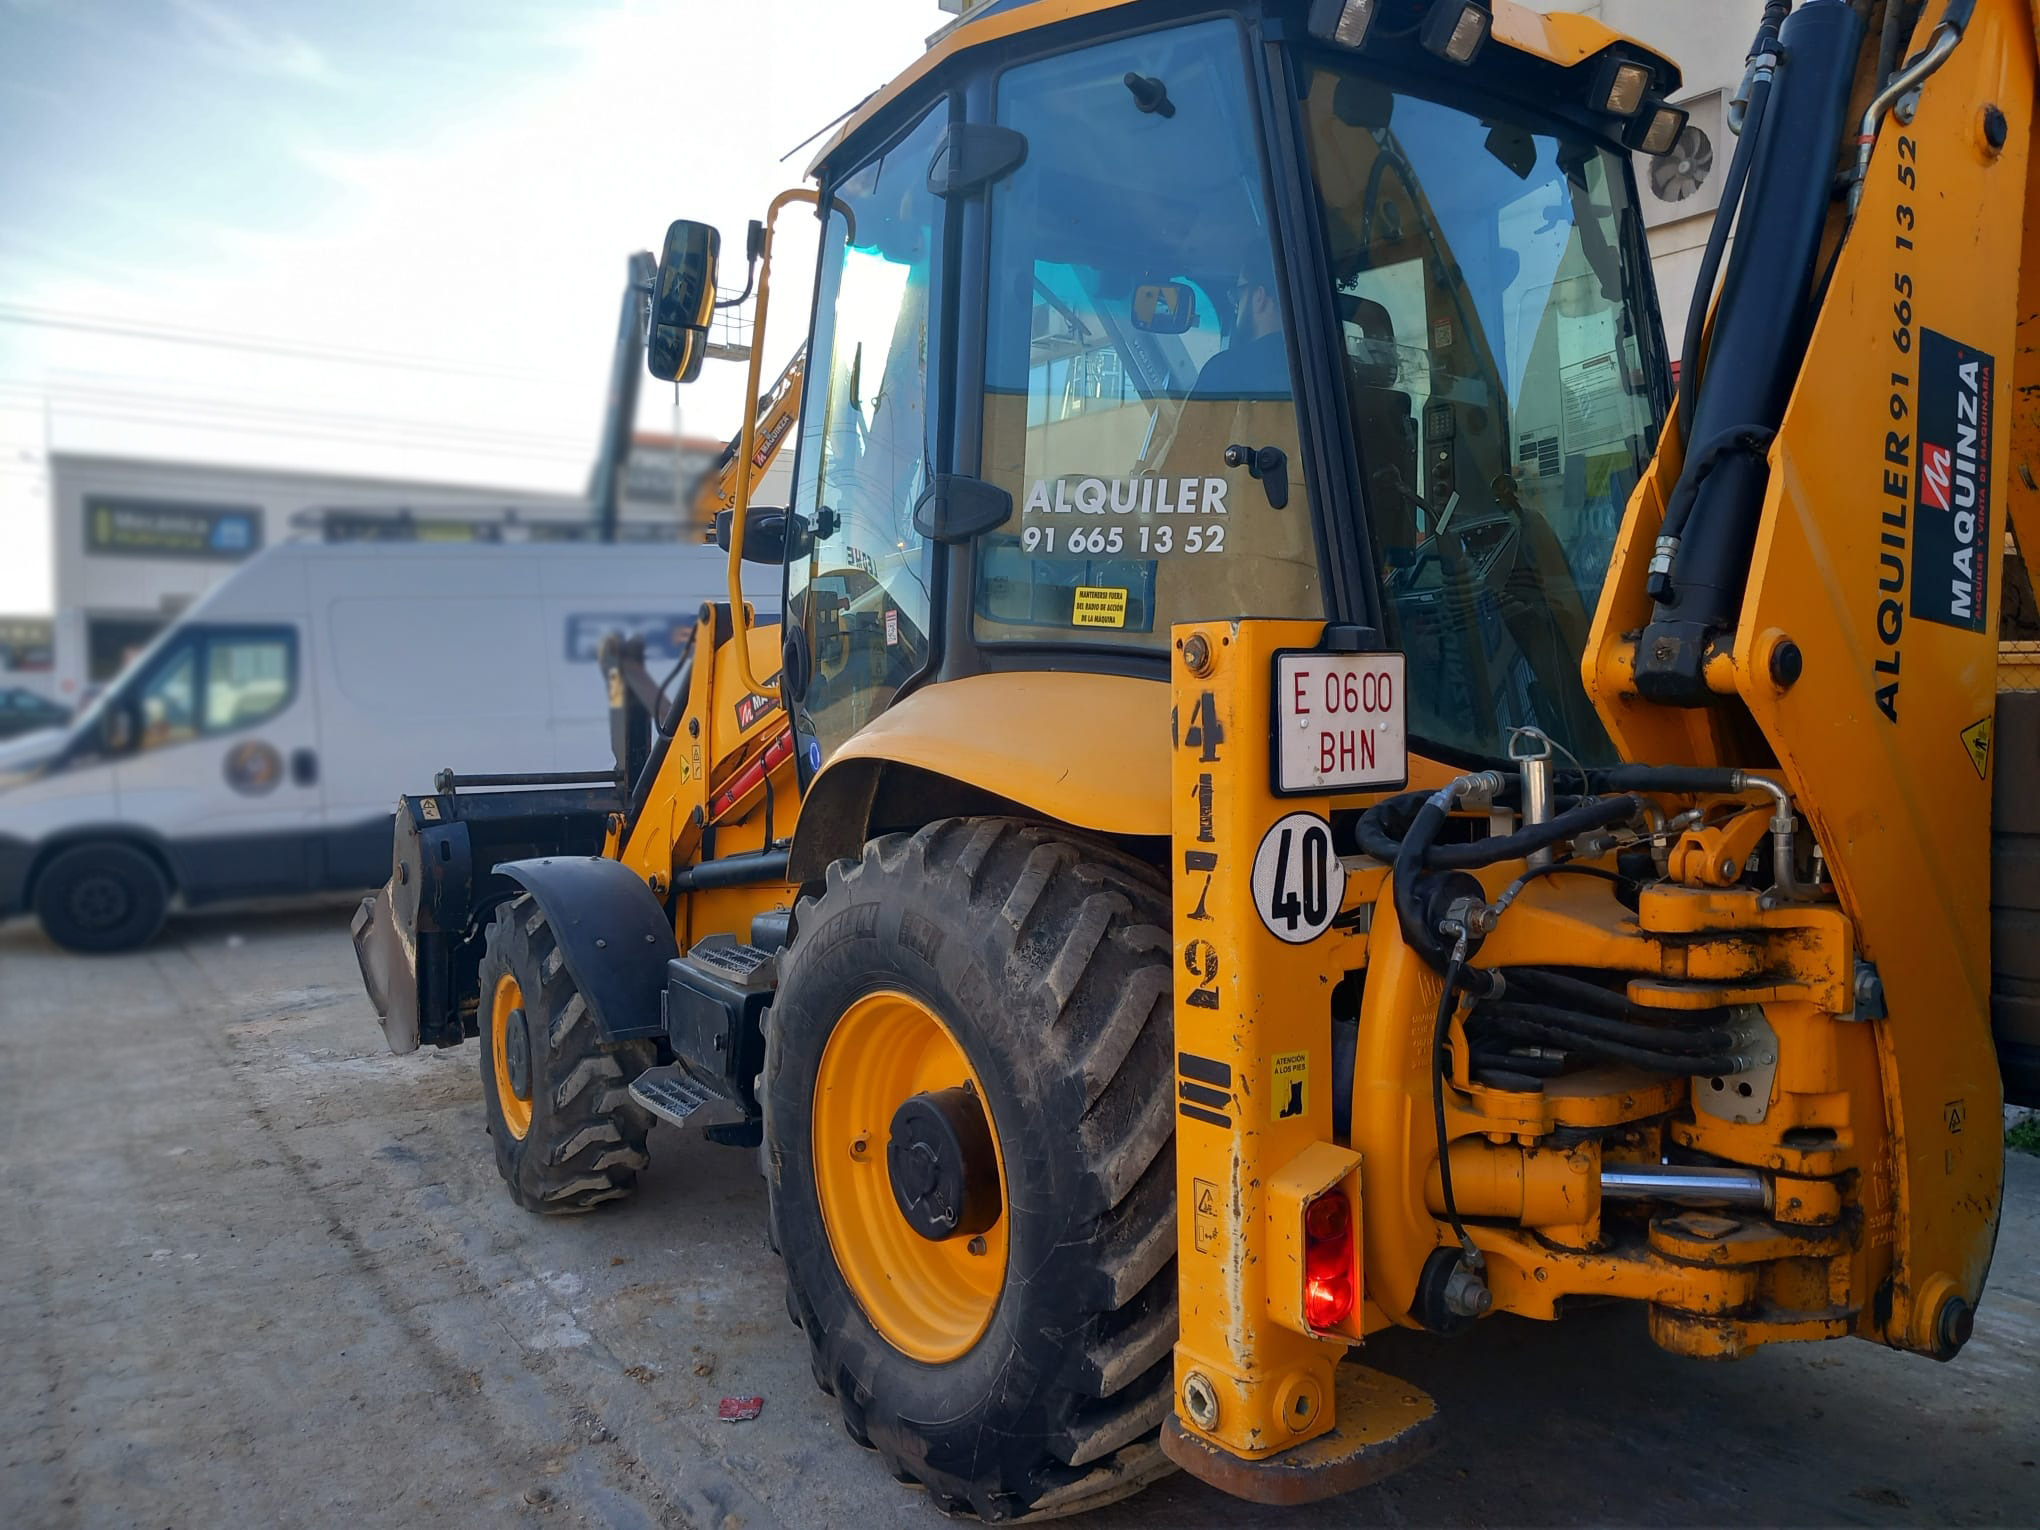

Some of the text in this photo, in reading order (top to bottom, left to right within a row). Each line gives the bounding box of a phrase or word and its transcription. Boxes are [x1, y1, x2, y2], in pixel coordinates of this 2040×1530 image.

[1874, 135, 1916, 725] ALQUILER 91 665 13 52
[1980, 367, 1991, 461] MAQUINARIA
[1951, 361, 1979, 619] MAQUINZA
[1979, 464, 1987, 482] DE
[1023, 478, 1229, 515] ALQUILER
[1977, 489, 1986, 533] VENTA
[1023, 524, 1226, 554] 91 665 13 52
[1080, 591, 1122, 600] MANTENERSE FUERA
[1085, 602, 1100, 611] RADIO
[1100, 603, 1106, 611] DE
[1974, 552, 1985, 620] ALQUILER
[1293, 671, 1393, 715] E 0600
[1320, 729, 1376, 774] BHN
[1271, 826, 1328, 931] 40
[1274, 1066, 1279, 1075] A
[1279, 1065, 1292, 1074] LOS
[1276, 1054, 1305, 1065] ATENCIÓN
